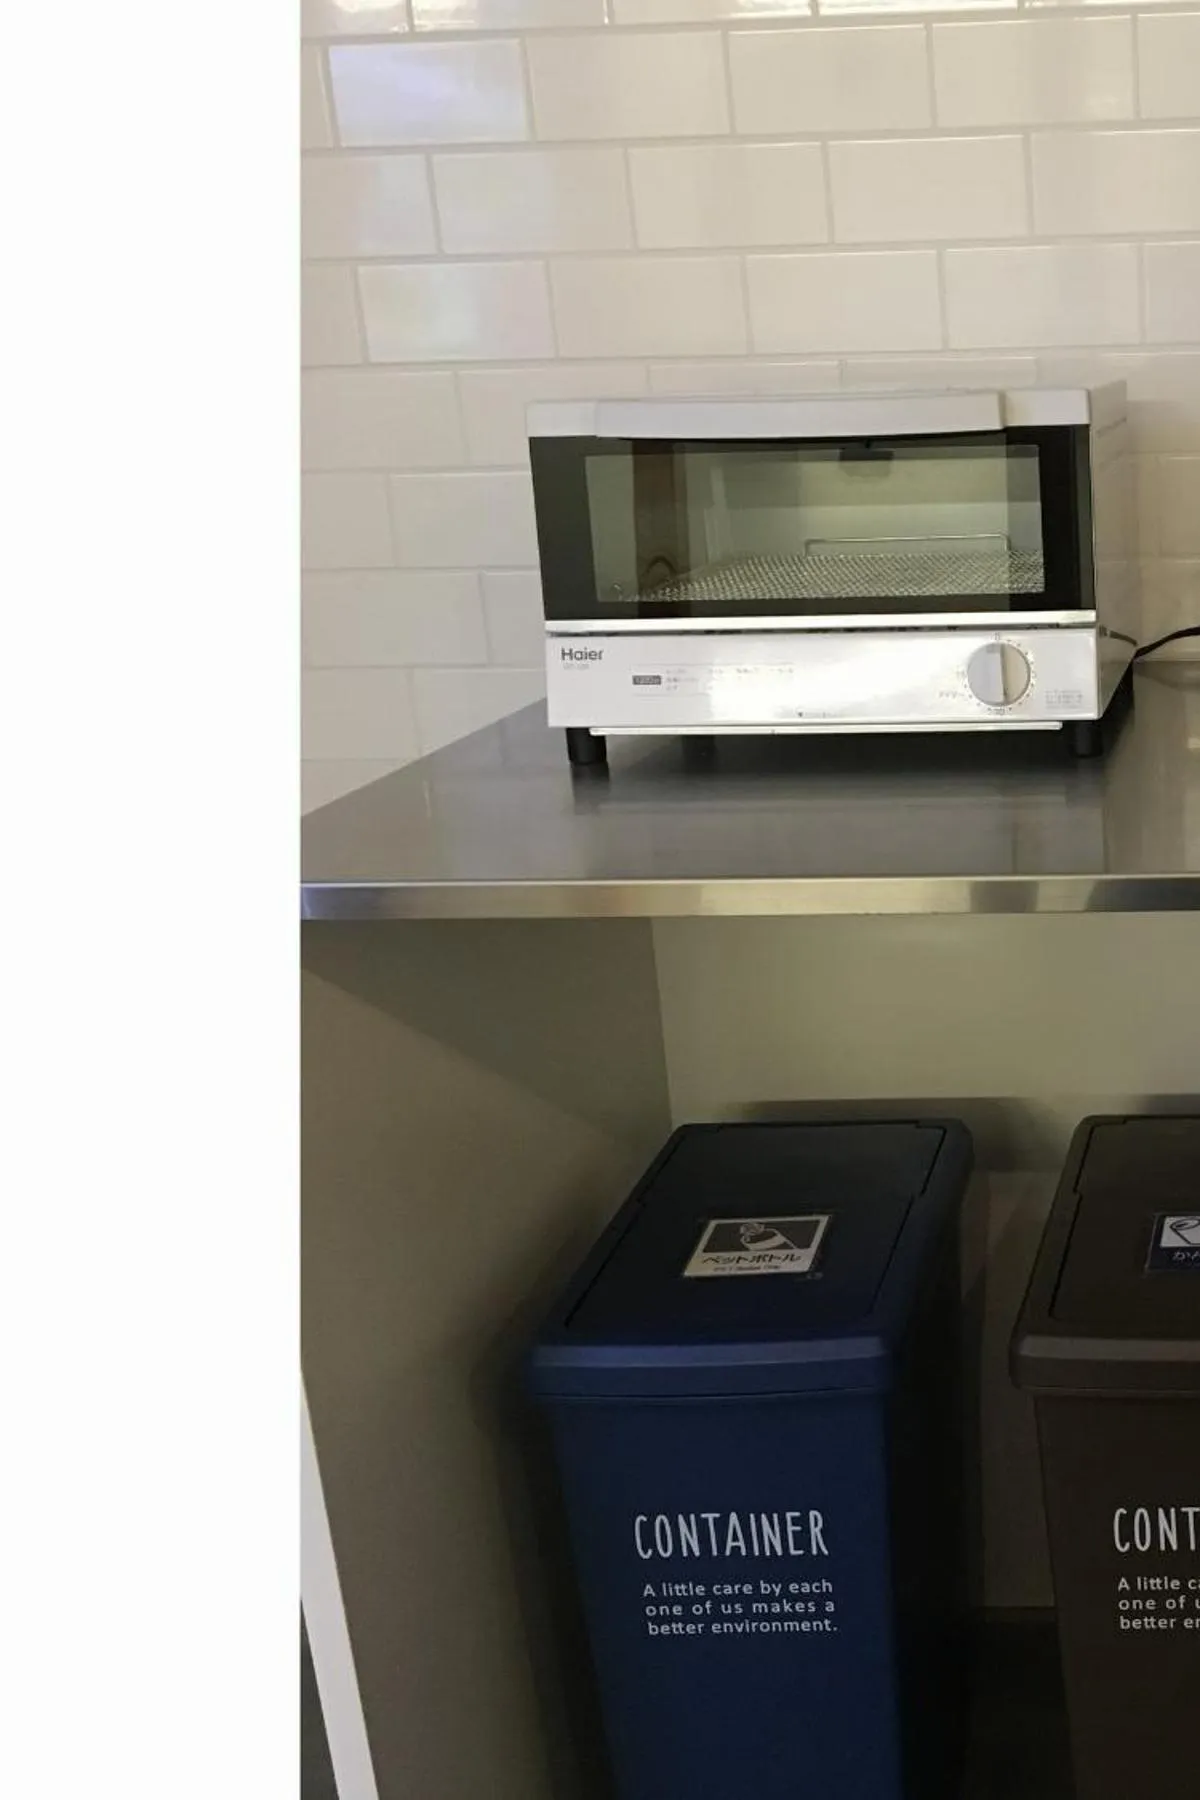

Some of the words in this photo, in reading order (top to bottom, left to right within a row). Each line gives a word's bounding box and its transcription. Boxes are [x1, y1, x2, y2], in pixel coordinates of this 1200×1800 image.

[561, 647, 604, 661] Haier
[634, 1510, 829, 1559] CONTAINER
[643, 1584, 655, 1597] A
[662, 1582, 706, 1596] little
[713, 1583, 753, 1595] care
[760, 1580, 782, 1596] by
[789, 1579, 833, 1594] each
[1118, 1577, 1130, 1591] A
[1137, 1576, 1180, 1591] little
[646, 1604, 683, 1616] one
[692, 1600, 712, 1615] of
[721, 1602, 743, 1613] us
[752, 1599, 816, 1613] makes
[825, 1600, 835, 1612] a
[1118, 1599, 1157, 1610] one
[1166, 1595, 1186, 1610] of
[648, 1621, 704, 1635] better
[712, 1619, 838, 1633] environment.
[1120, 1616, 1176, 1630] better
